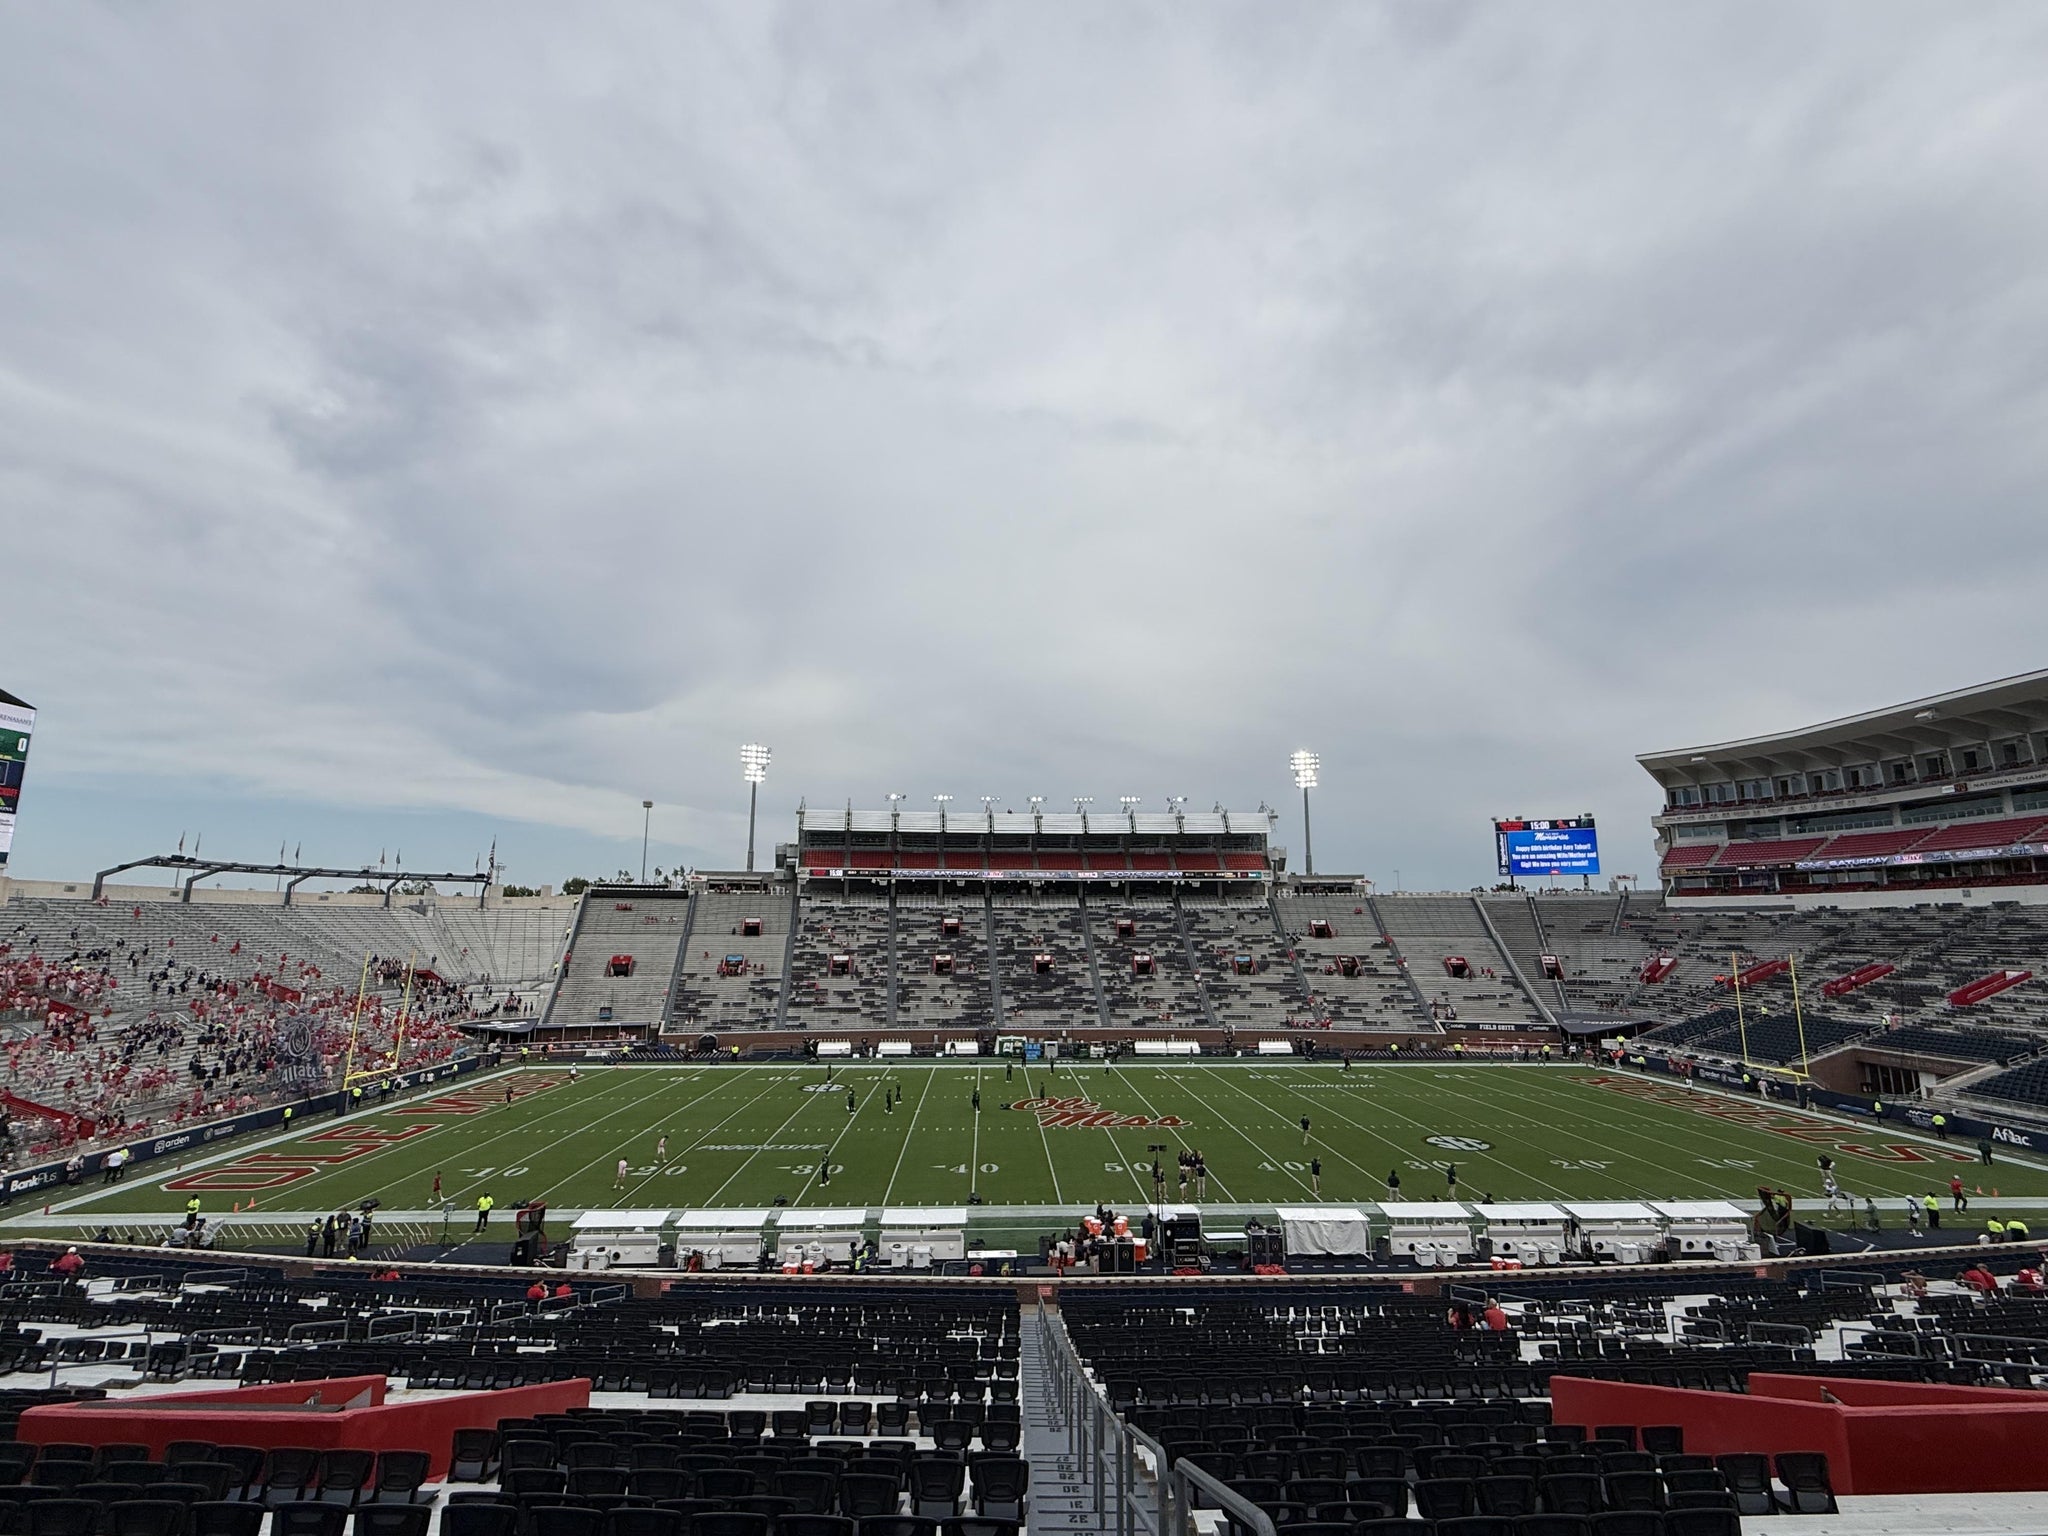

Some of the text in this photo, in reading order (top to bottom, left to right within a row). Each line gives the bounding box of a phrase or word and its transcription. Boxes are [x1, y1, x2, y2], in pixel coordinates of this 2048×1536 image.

[17, 738, 27, 752] 0
[1530, 821, 1550, 830] 15:00
[1828, 856, 1888, 868] SATURDAY
[801, 1083, 846, 1093] SEC
[1010, 1096, 1101, 1113] Ole
[1034, 1109, 1193, 1128] Miss
[165, 1135, 190, 1149] arden
[1426, 1136, 1491, 1151] SEC
[159, 1124, 444, 1192] OLE
[950, 1163, 1000, 1174] 40
[1104, 1162, 1152, 1173] 50
[1257, 1160, 1306, 1172] 40
[10, 1171, 57, 1193] BankPlus
[1070, 1501, 1083, 1509] 31
[1068, 1514, 1088, 1524] 32
